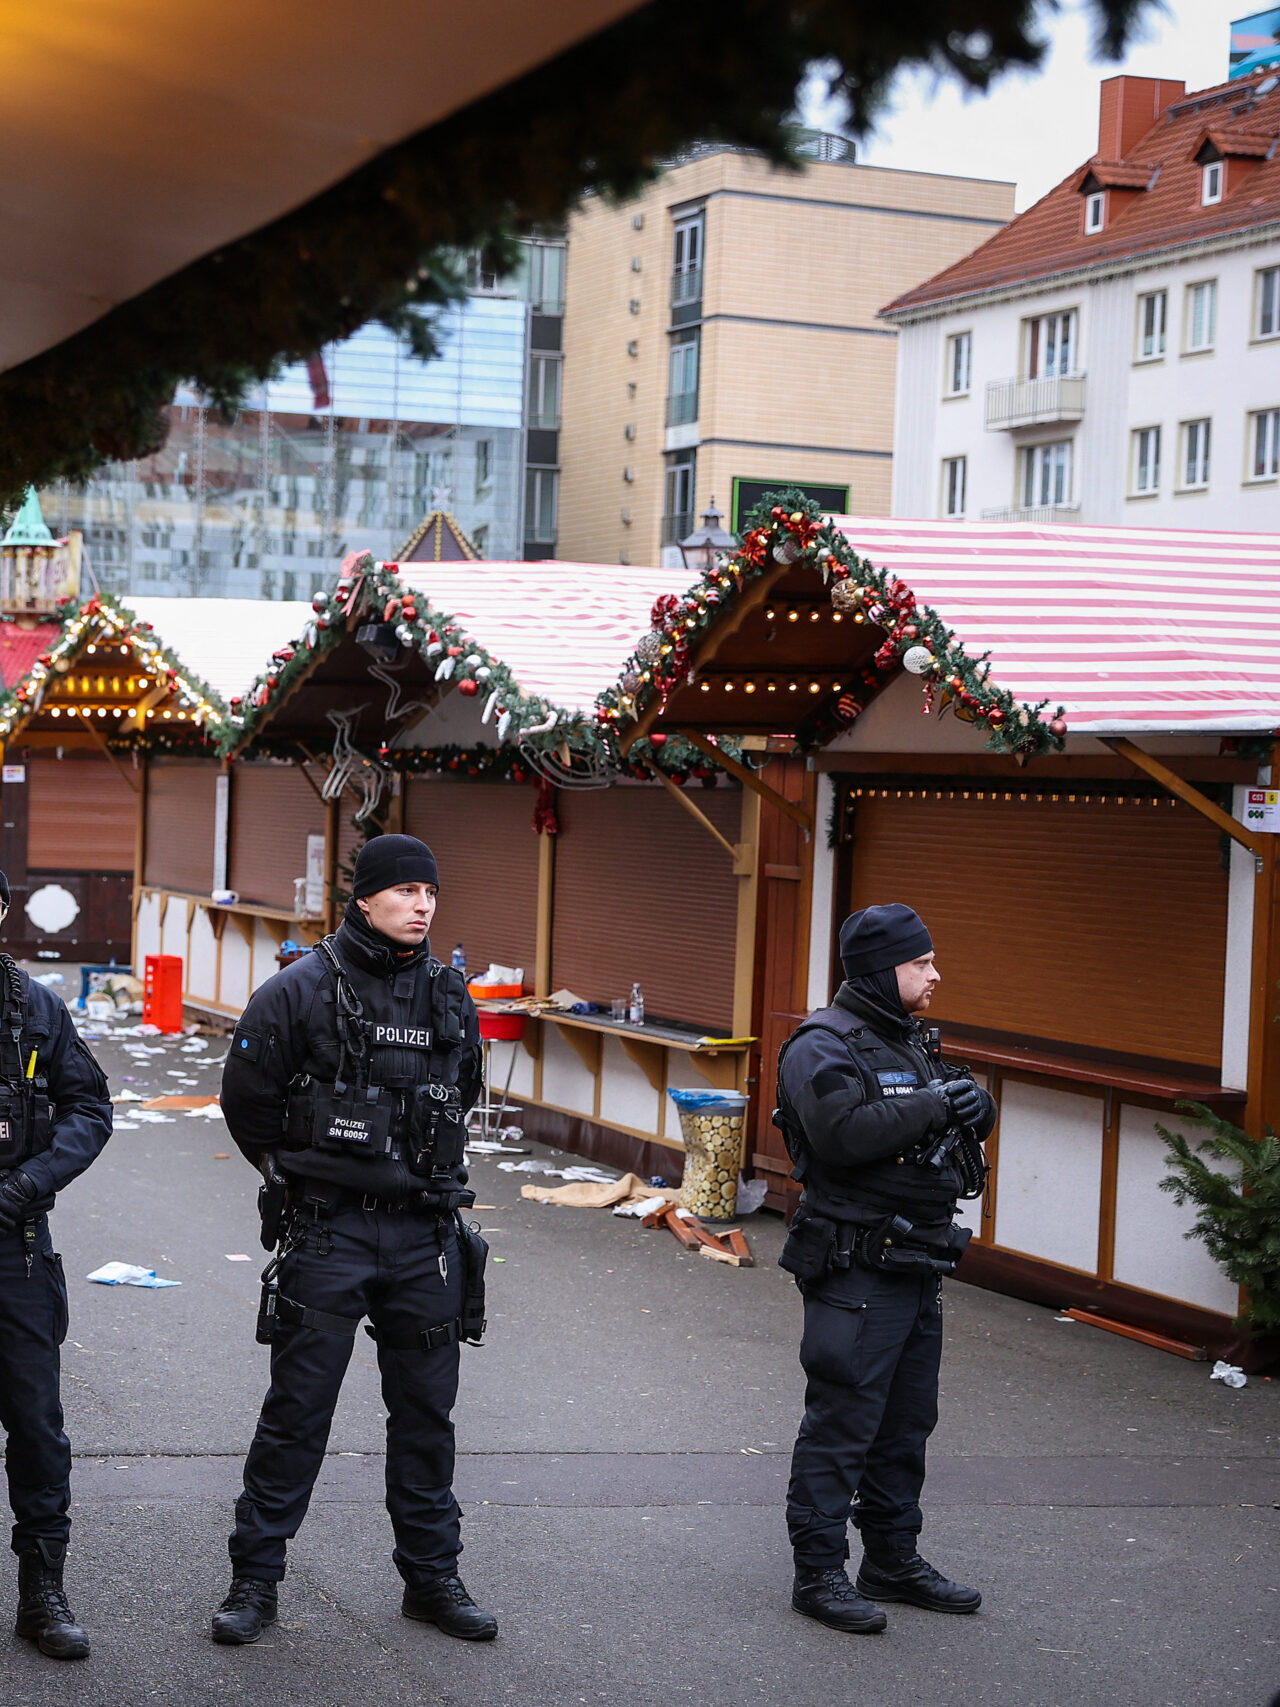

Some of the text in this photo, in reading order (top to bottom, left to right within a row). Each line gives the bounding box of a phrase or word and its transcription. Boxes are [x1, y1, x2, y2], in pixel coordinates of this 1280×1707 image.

[376, 1026, 431, 1046] POLIZEI
[882, 1087, 895, 1096] SN
[334, 1118, 365, 1130] POLIZEI
[328, 1127, 369, 1140] SN 60057
